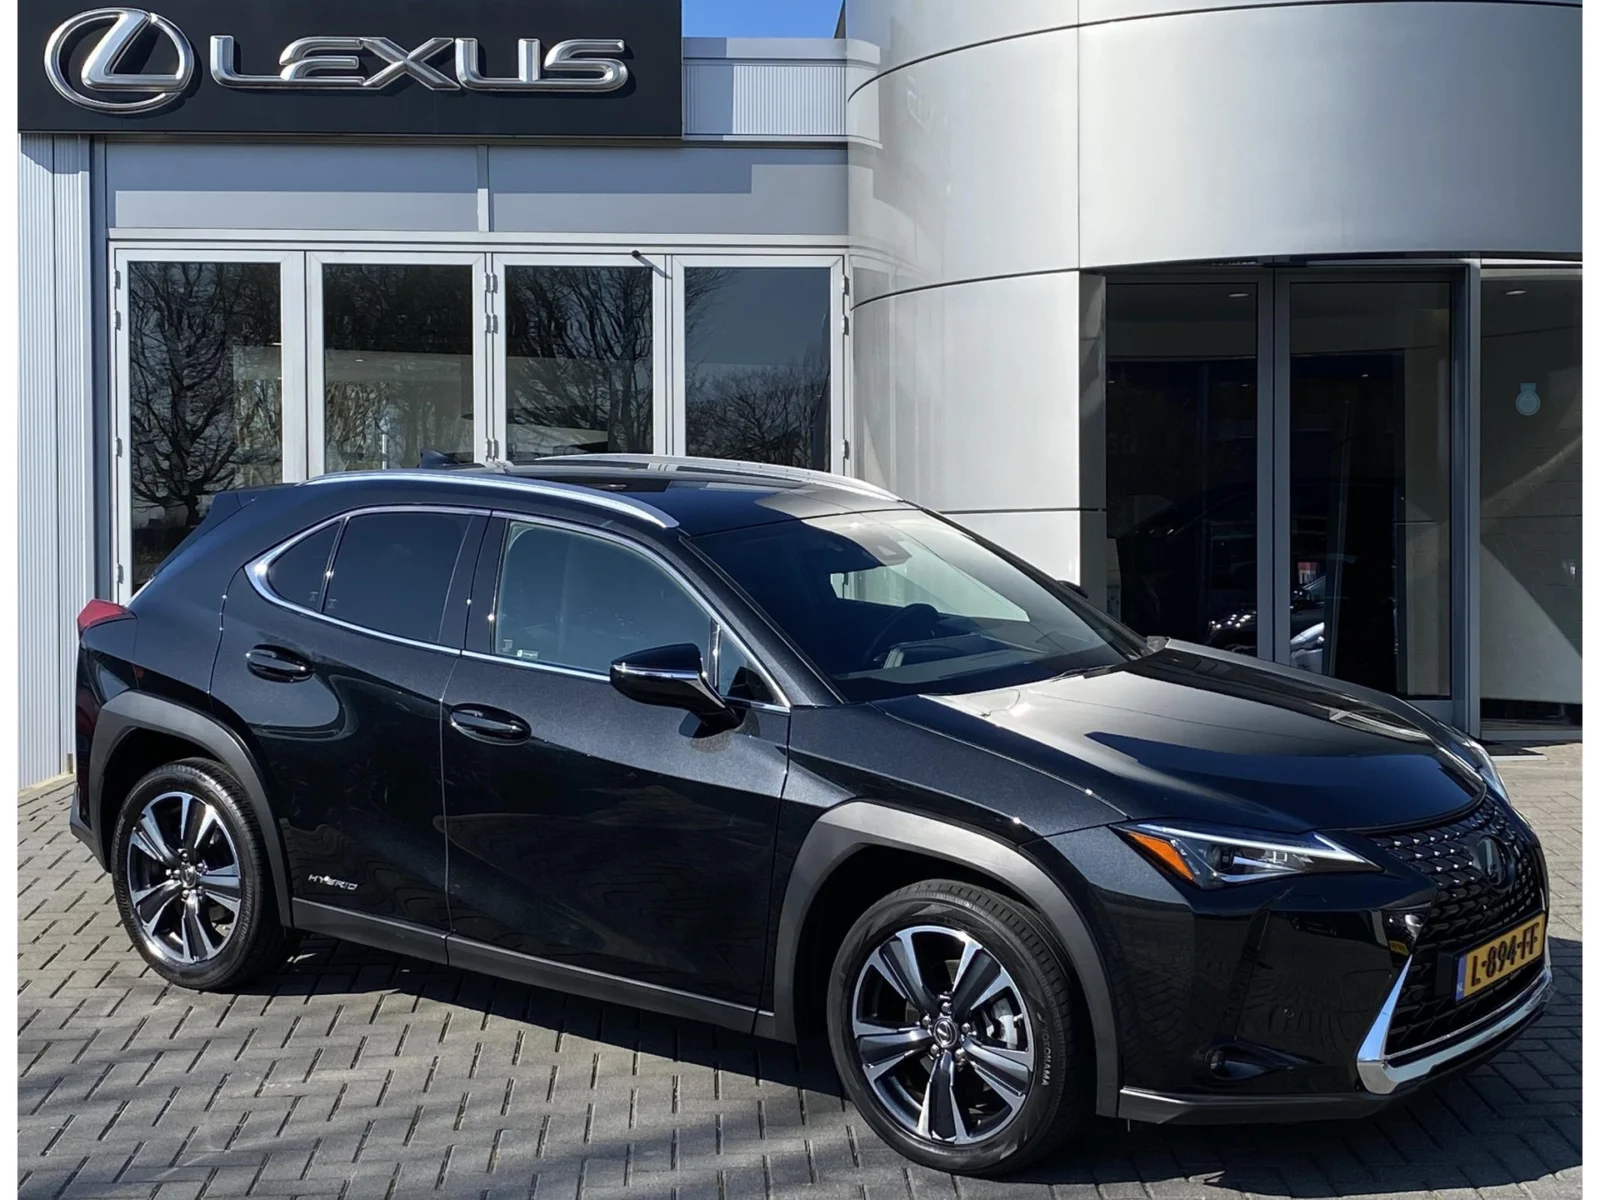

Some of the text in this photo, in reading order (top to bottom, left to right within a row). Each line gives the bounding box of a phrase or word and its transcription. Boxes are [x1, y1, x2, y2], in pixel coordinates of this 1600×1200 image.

[209, 34, 629, 93] LEXUS
[307, 873, 359, 891] HYBRID
[1471, 921, 1540, 987] L-894-FF
